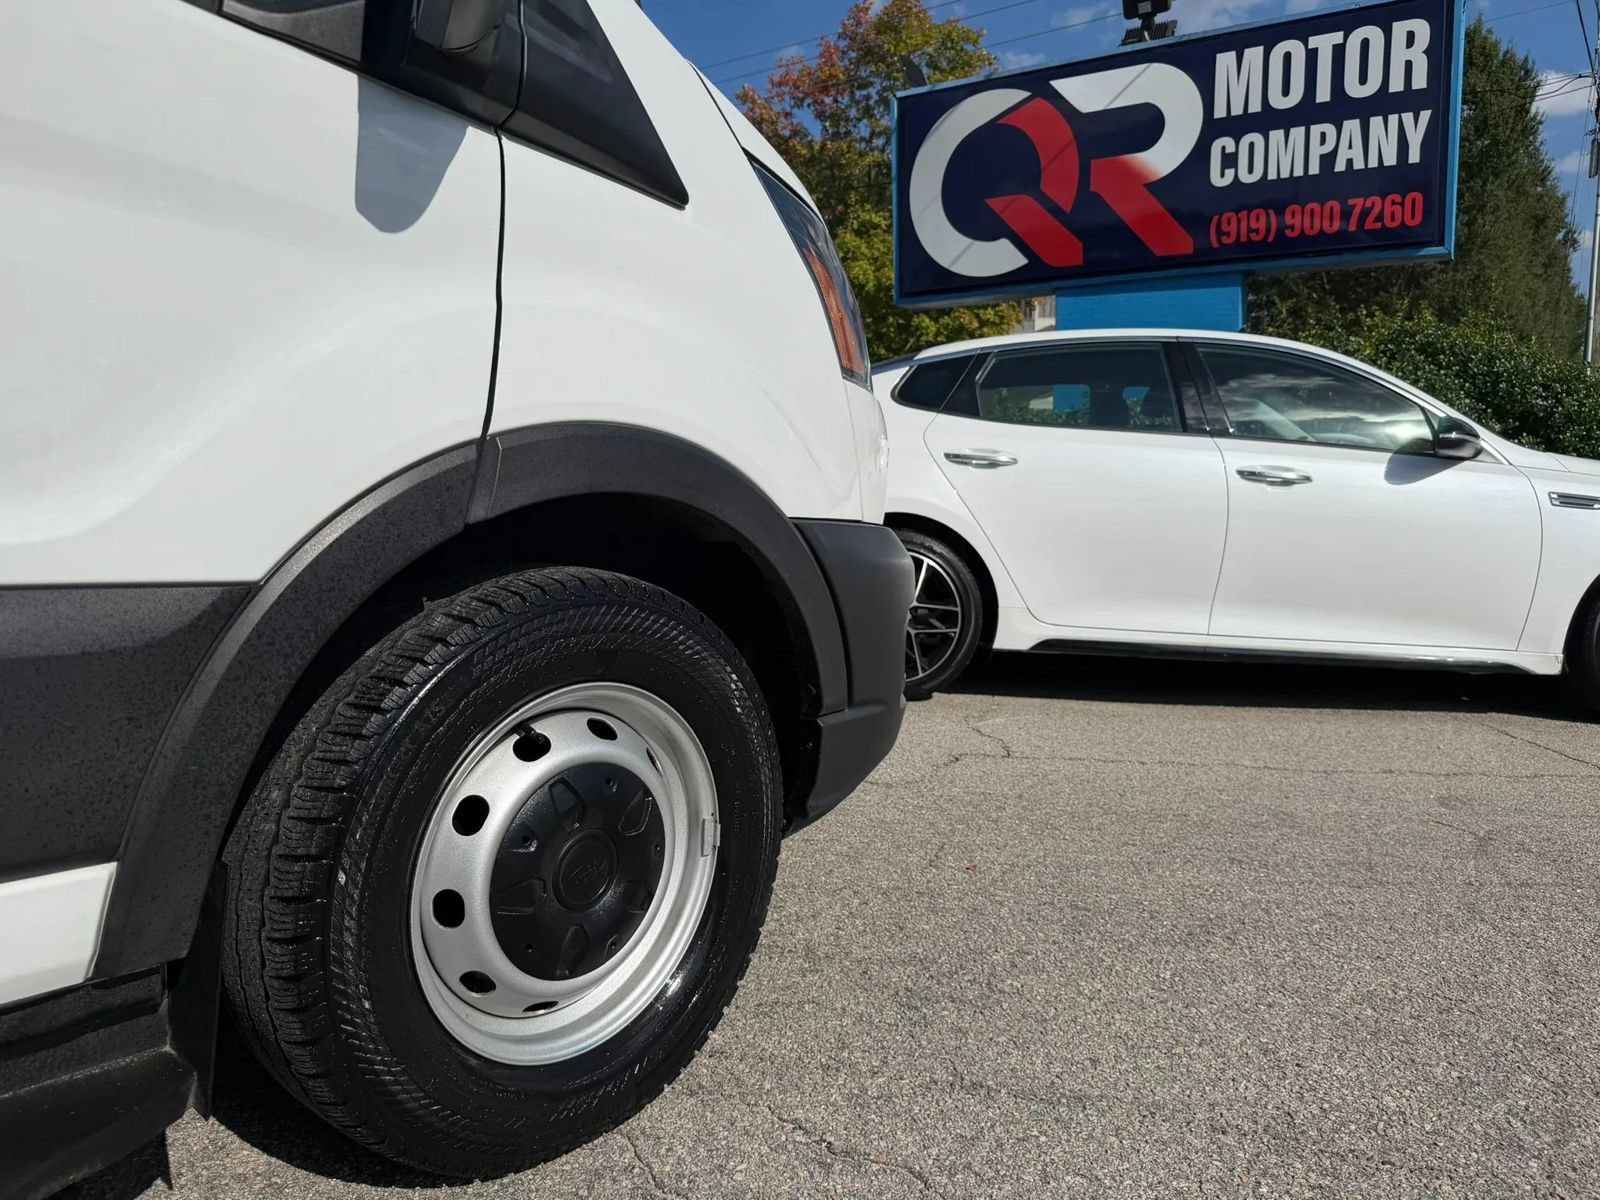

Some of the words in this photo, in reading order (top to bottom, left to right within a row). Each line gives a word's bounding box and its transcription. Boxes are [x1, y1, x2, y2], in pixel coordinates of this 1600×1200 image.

[1213, 18, 1431, 119] MOTOR
[908, 62, 1204, 277] QR
[1209, 109, 1432, 187] COMPANY
[1209, 209, 1278, 248] (919)
[1285, 200, 1341, 238] 900
[1348, 191, 1423, 232] 7260
